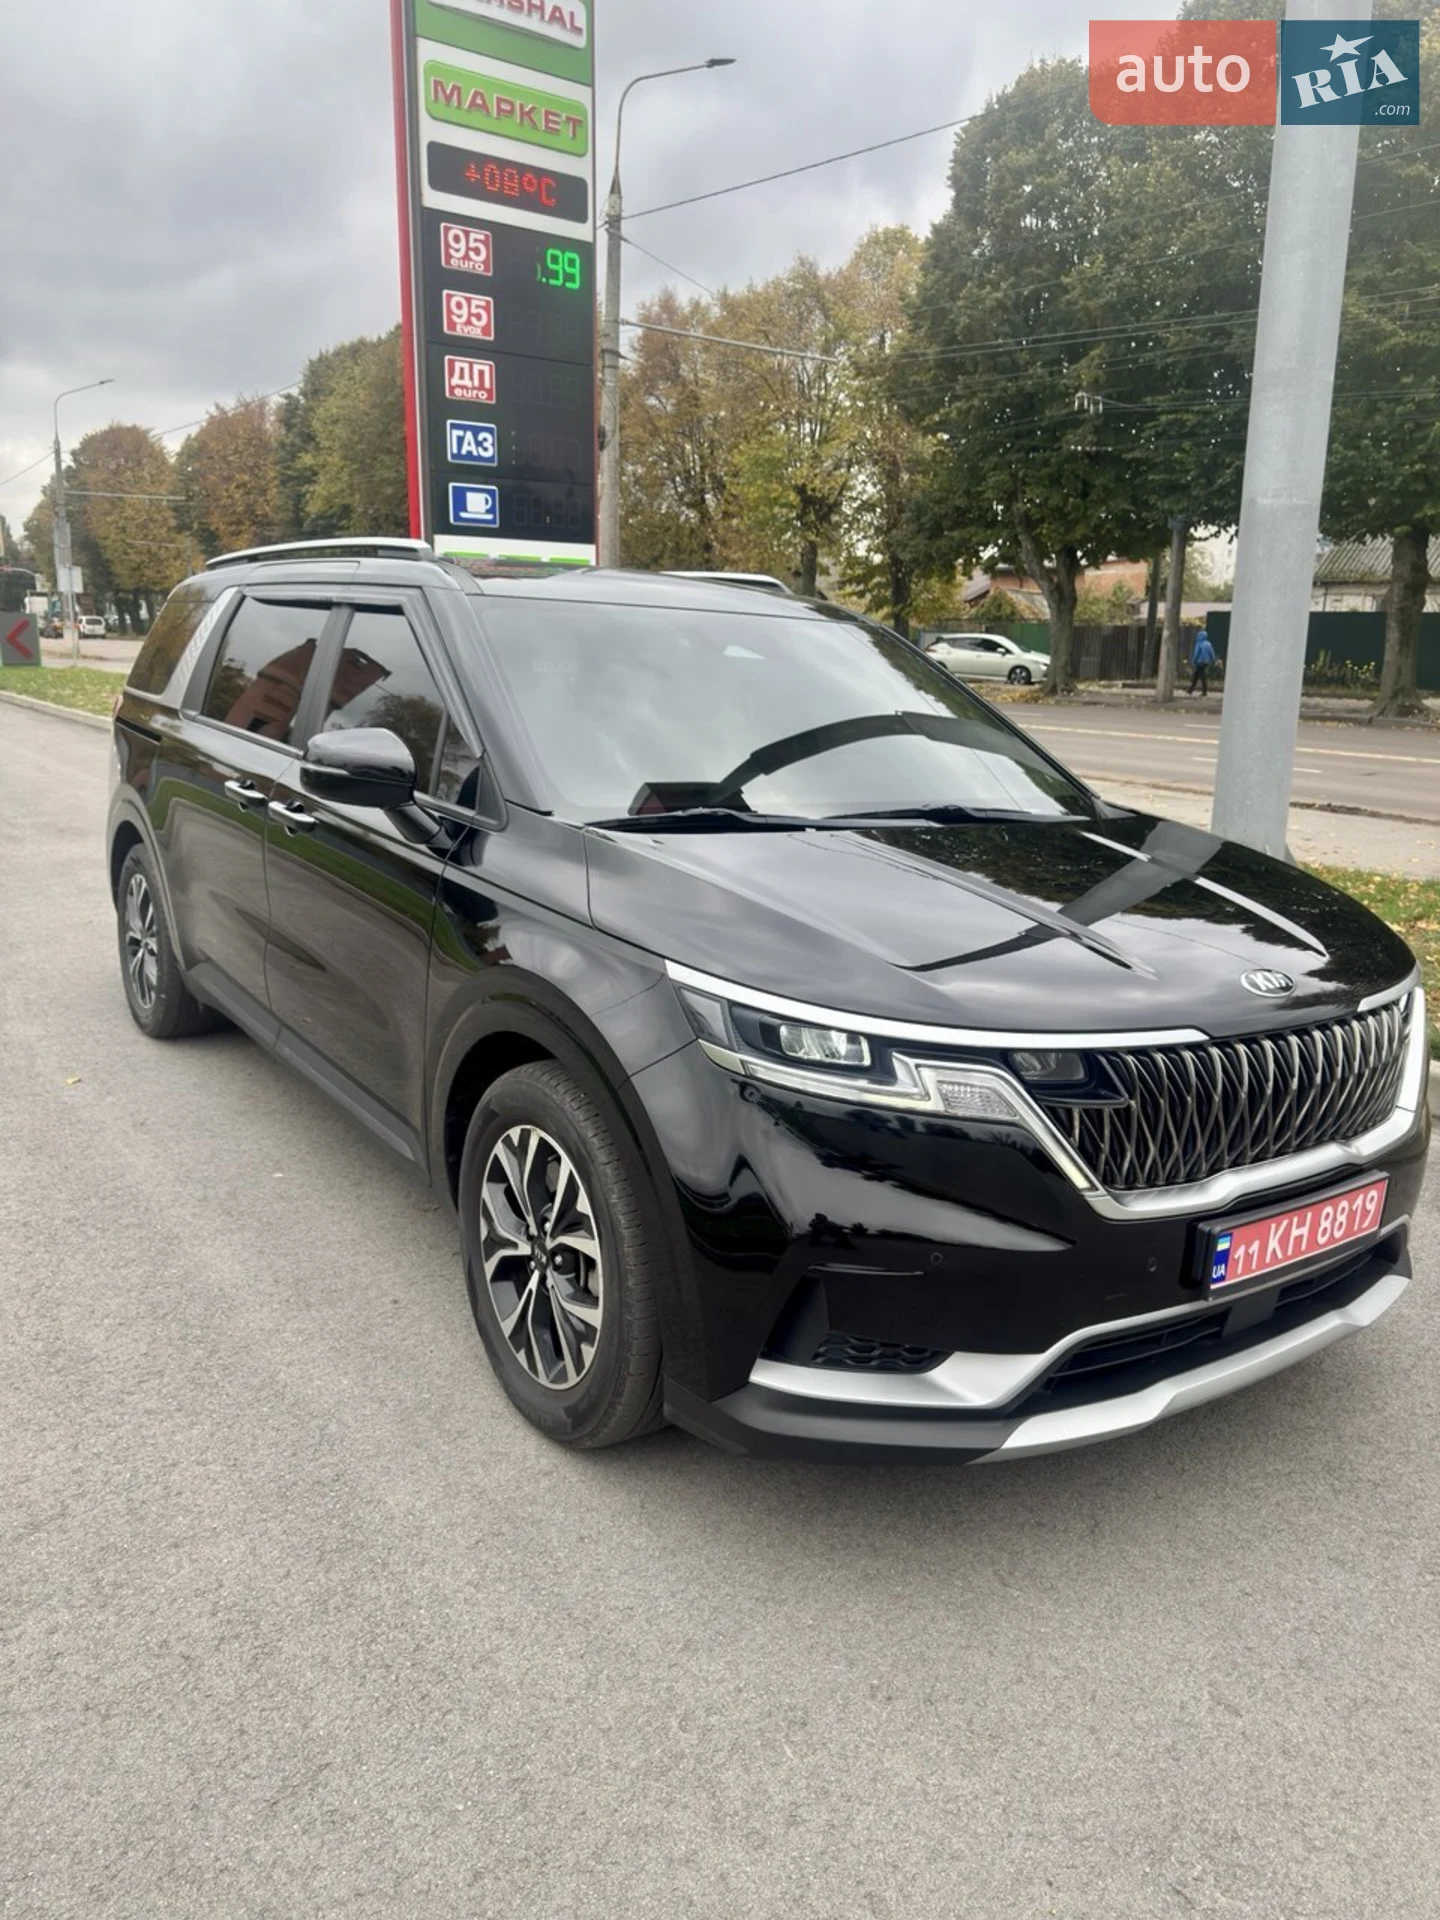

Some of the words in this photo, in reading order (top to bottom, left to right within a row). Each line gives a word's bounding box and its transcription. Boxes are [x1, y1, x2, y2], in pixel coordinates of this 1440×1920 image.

[430, 78, 583, 141] МАРКЕТ
[448, 229, 487, 260] 95
[450, 257, 485, 272] euro
[450, 296, 488, 327] 95
[451, 361, 491, 389] ДП
[454, 388, 488, 400] euro
[451, 429, 494, 458] ГАЗ
[1211, 1262, 1227, 1279] UA
